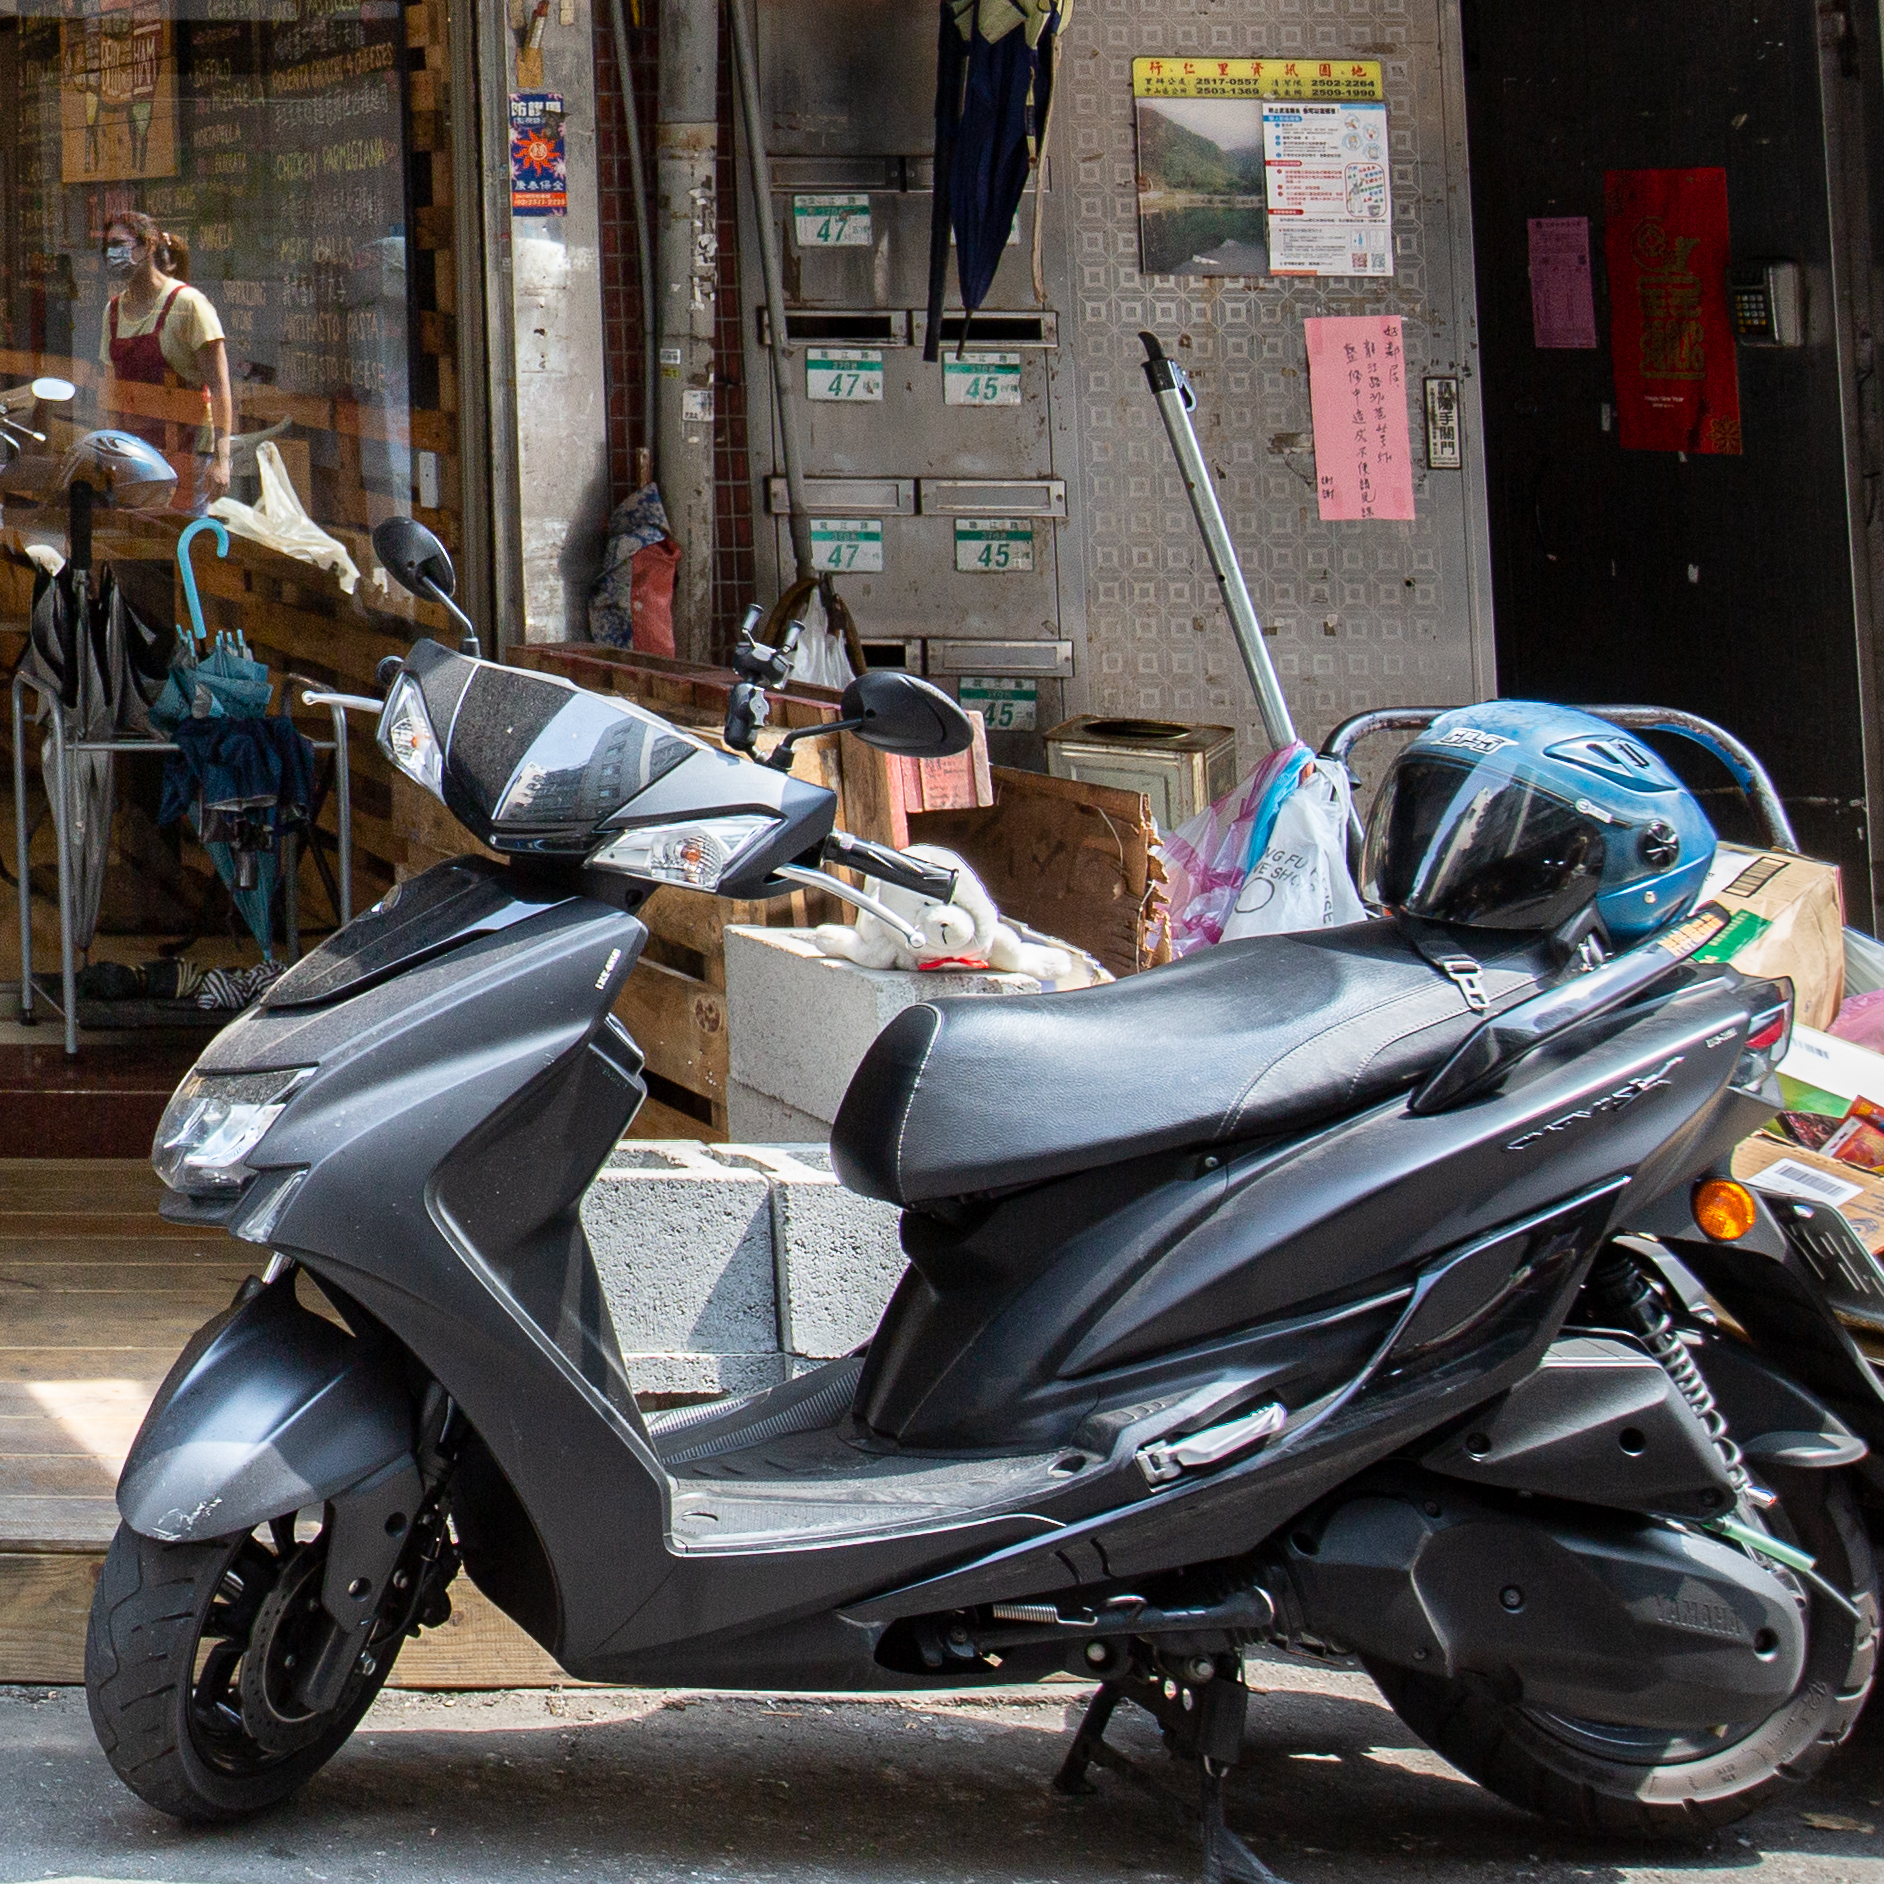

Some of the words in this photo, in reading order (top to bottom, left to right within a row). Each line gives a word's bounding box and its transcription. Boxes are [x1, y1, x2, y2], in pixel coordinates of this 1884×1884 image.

[1195, 77, 1260, 86] 2517-0557
[1311, 79, 1375, 88] 2502-2264
[817, 218, 849, 242] 47
[828, 373, 860, 396] 47
[966, 377, 998, 400] 45
[828, 544, 860, 568] 47
[978, 543, 1011, 568] 45
[984, 703, 1014, 728] 45
